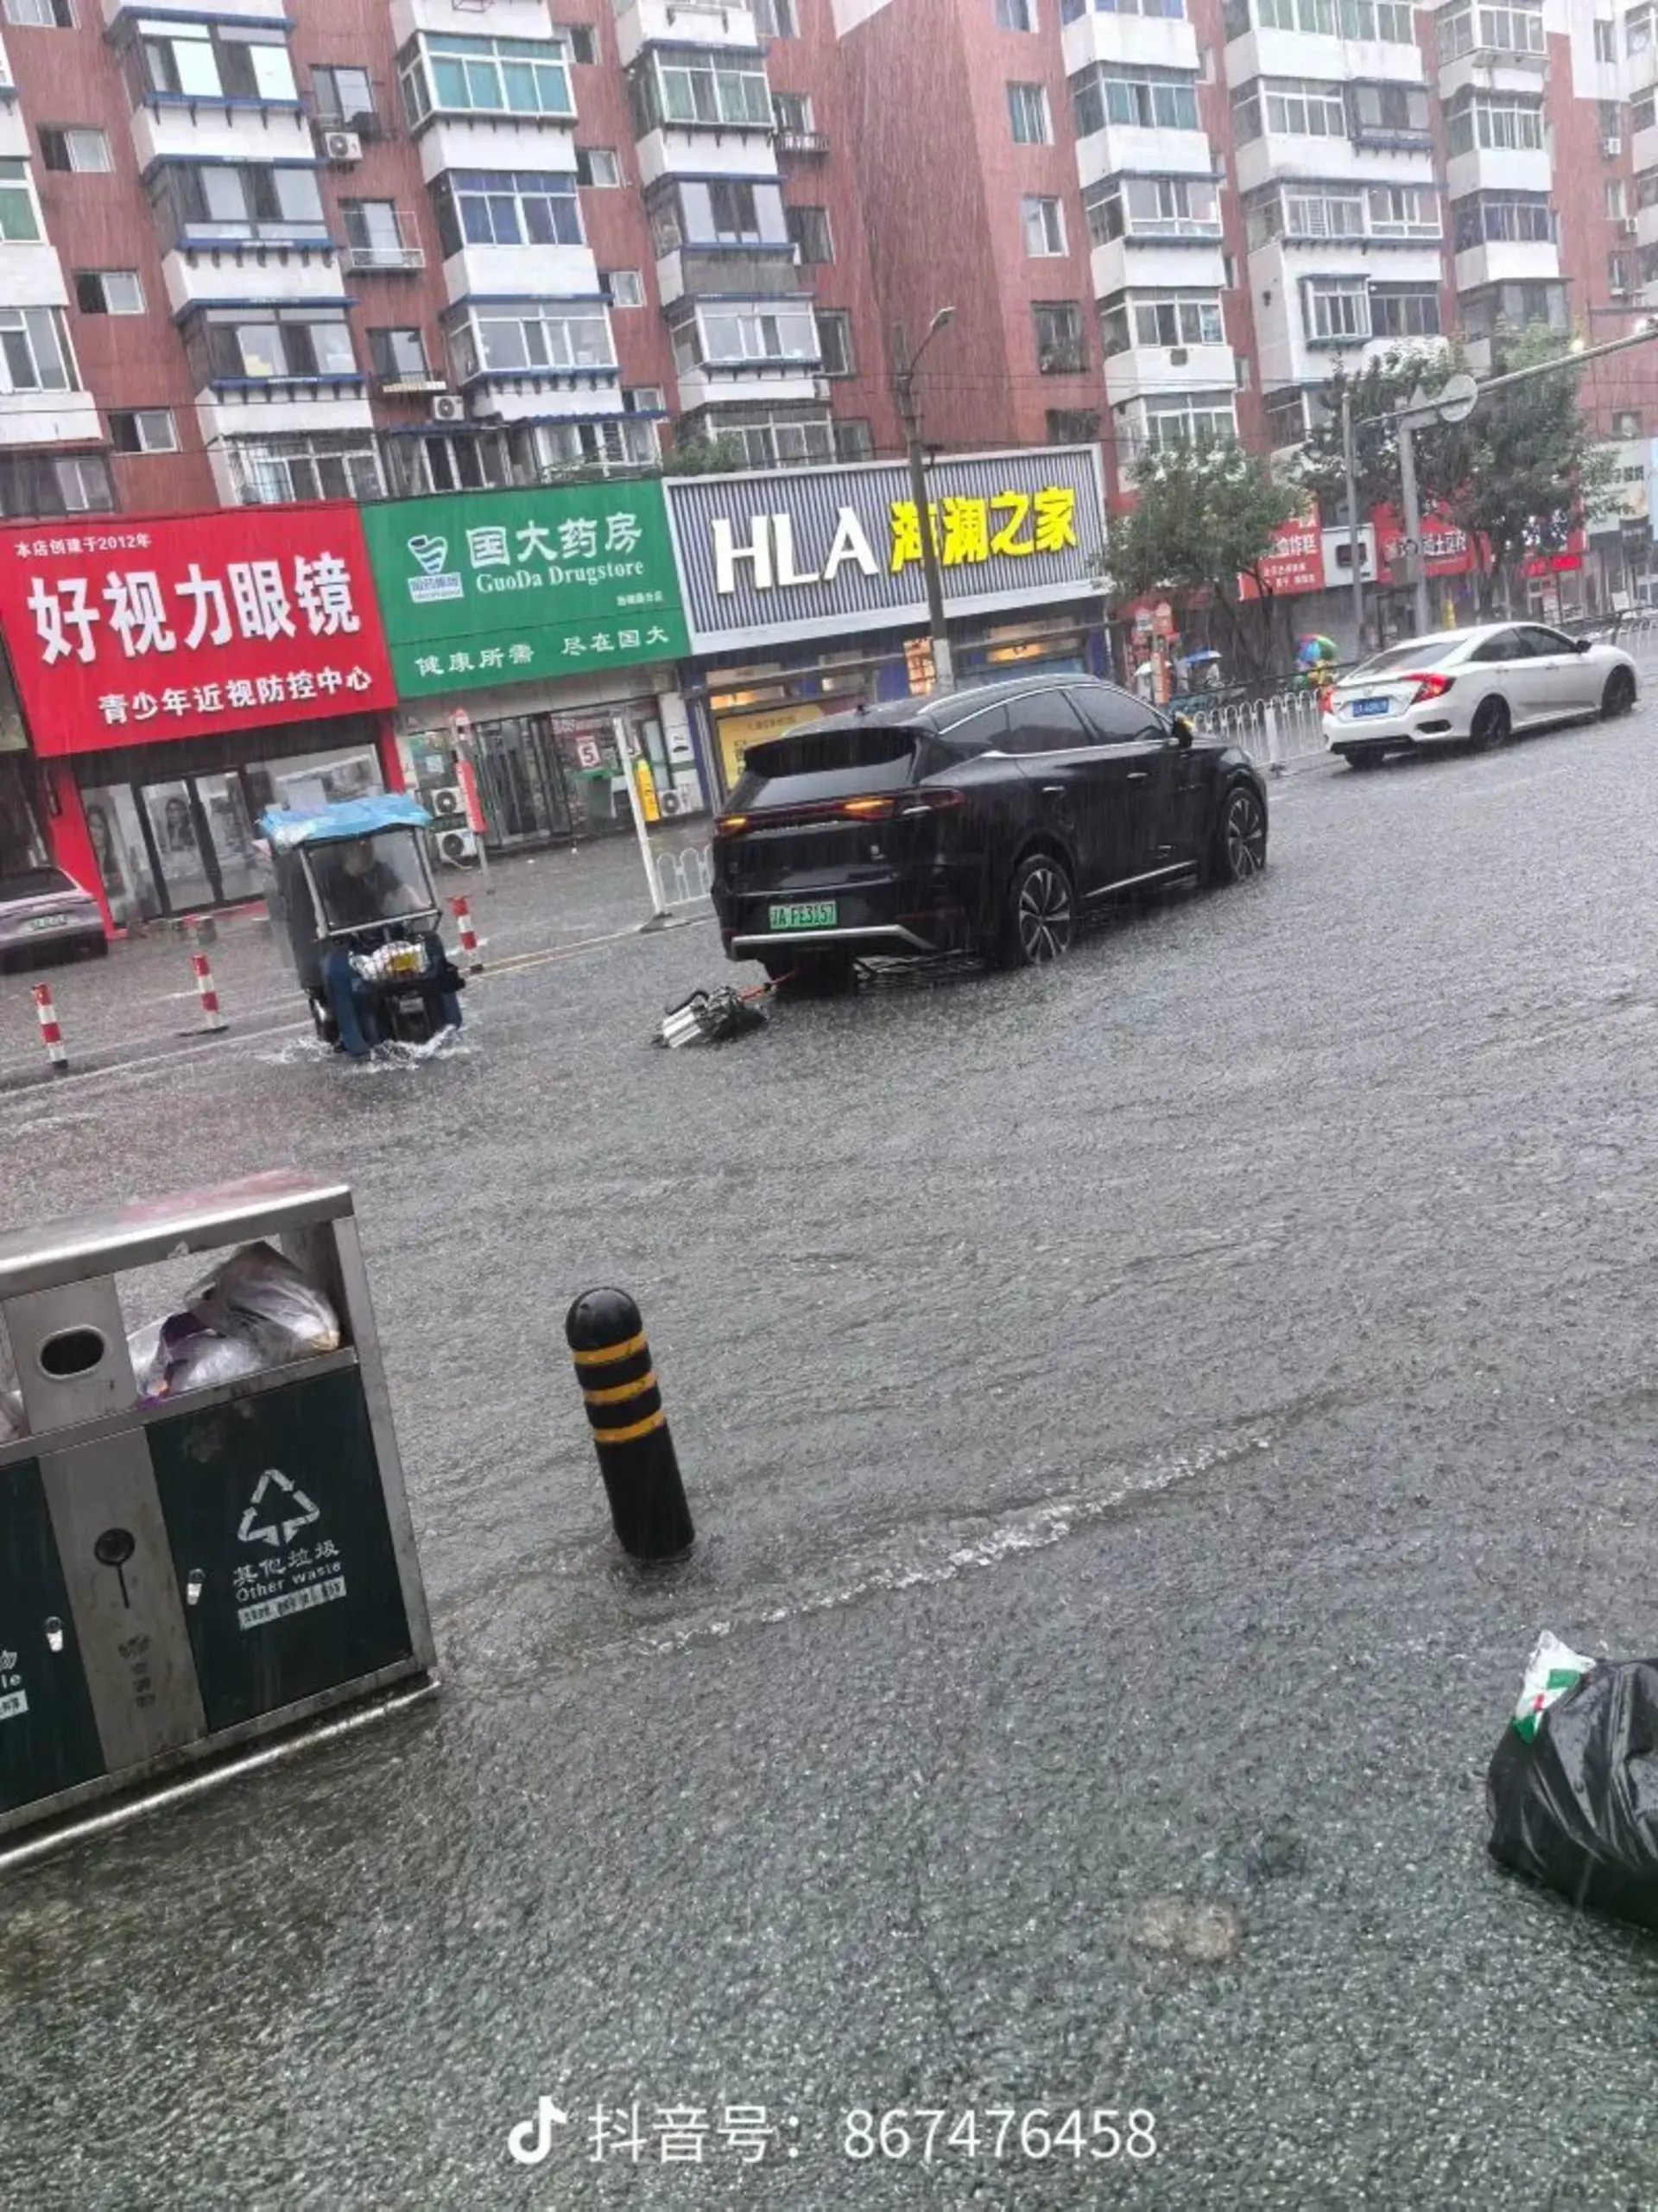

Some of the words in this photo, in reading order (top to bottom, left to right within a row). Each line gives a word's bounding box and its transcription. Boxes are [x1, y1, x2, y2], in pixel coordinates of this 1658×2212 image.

[15, 532, 152, 558] 本店创建于2012年
[465, 512, 643, 569] 国大药房
[712, 506, 881, 594] HLA
[476, 569, 543, 594] GuoDa
[549, 559, 646, 586] Drugstore
[27, 550, 361, 665] 好视力眼镜
[414, 643, 535, 677] 健康所需
[561, 625, 670, 657] 尽在国大
[98, 665, 373, 726] 青少年近视防控中心
[233, 1539, 340, 1588] 其他垃圾
[236, 1579, 285, 1603] Other
